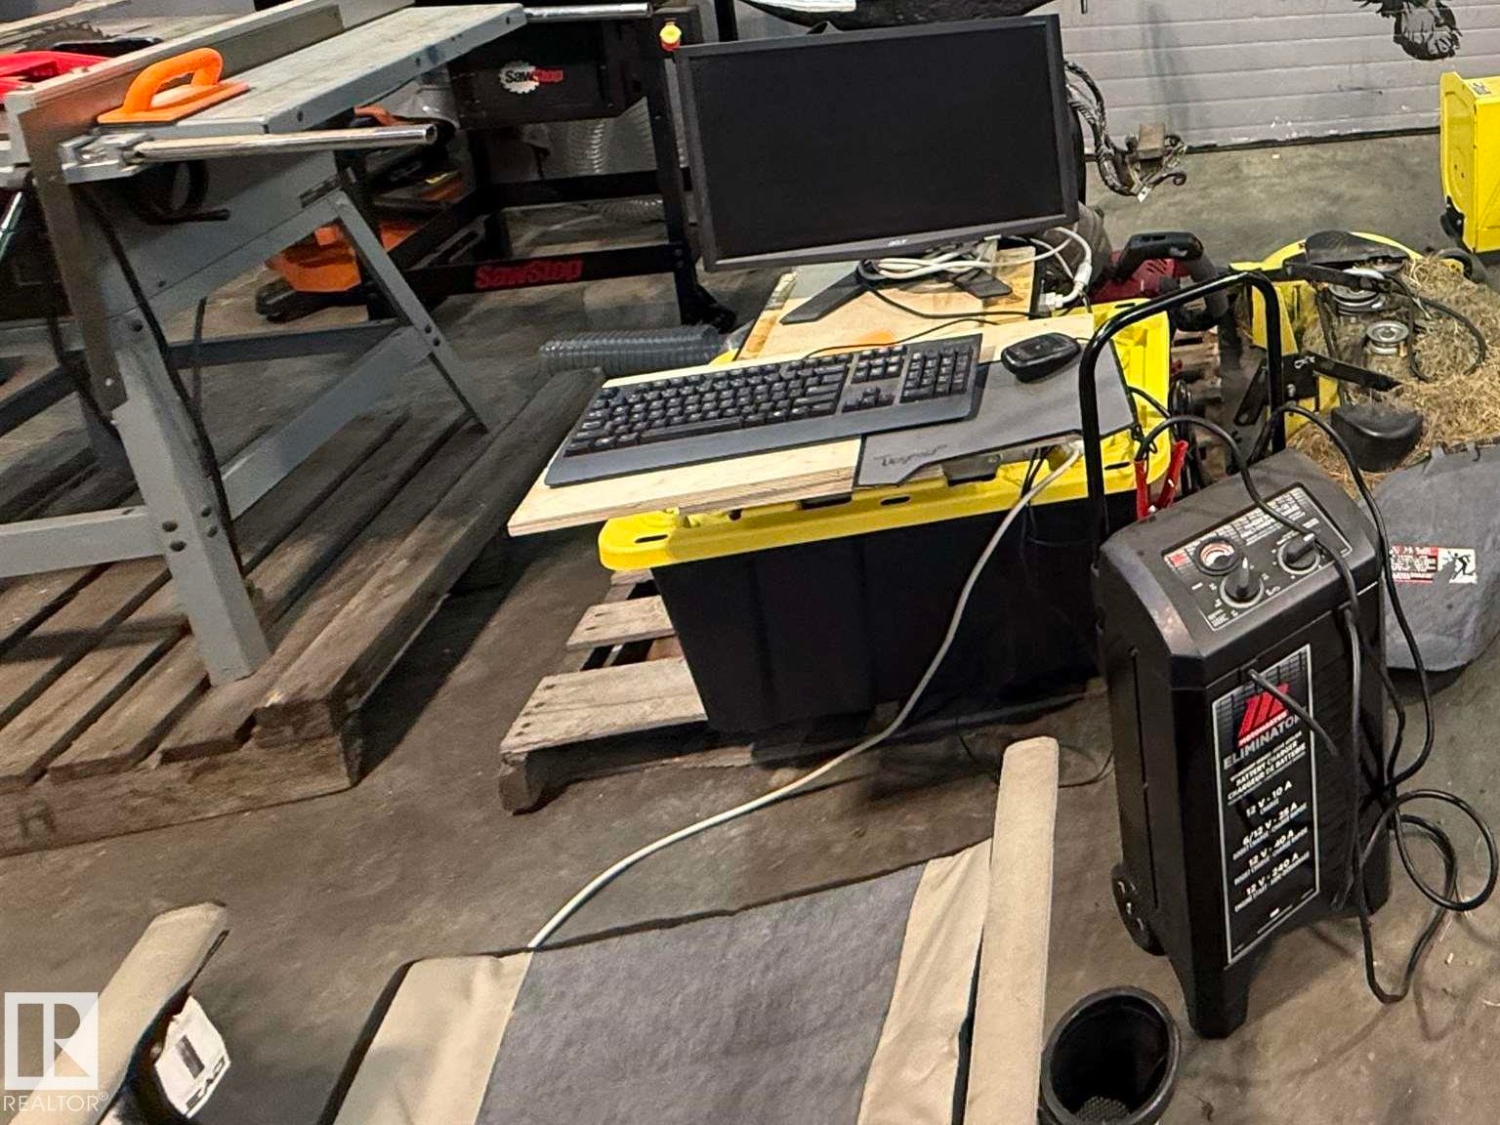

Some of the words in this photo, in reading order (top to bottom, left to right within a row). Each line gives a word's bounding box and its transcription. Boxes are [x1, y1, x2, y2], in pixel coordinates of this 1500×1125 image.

[475, 260, 582, 288] SawStop
[1236, 763, 1264, 786] BATTERY
[1246, 806, 1256, 818] 12
[1258, 799, 1264, 807] V
[1272, 786, 1282, 798] 10
[1284, 780, 1292, 791] A
[1265, 819, 1272, 829] V
[1290, 801, 1297, 812] A
[1260, 848, 1267, 858] V
[1273, 835, 1286, 848] 40
[1287, 829, 1293, 839] A
[1258, 876, 1265, 886] V
[1291, 852, 1298, 862] A
